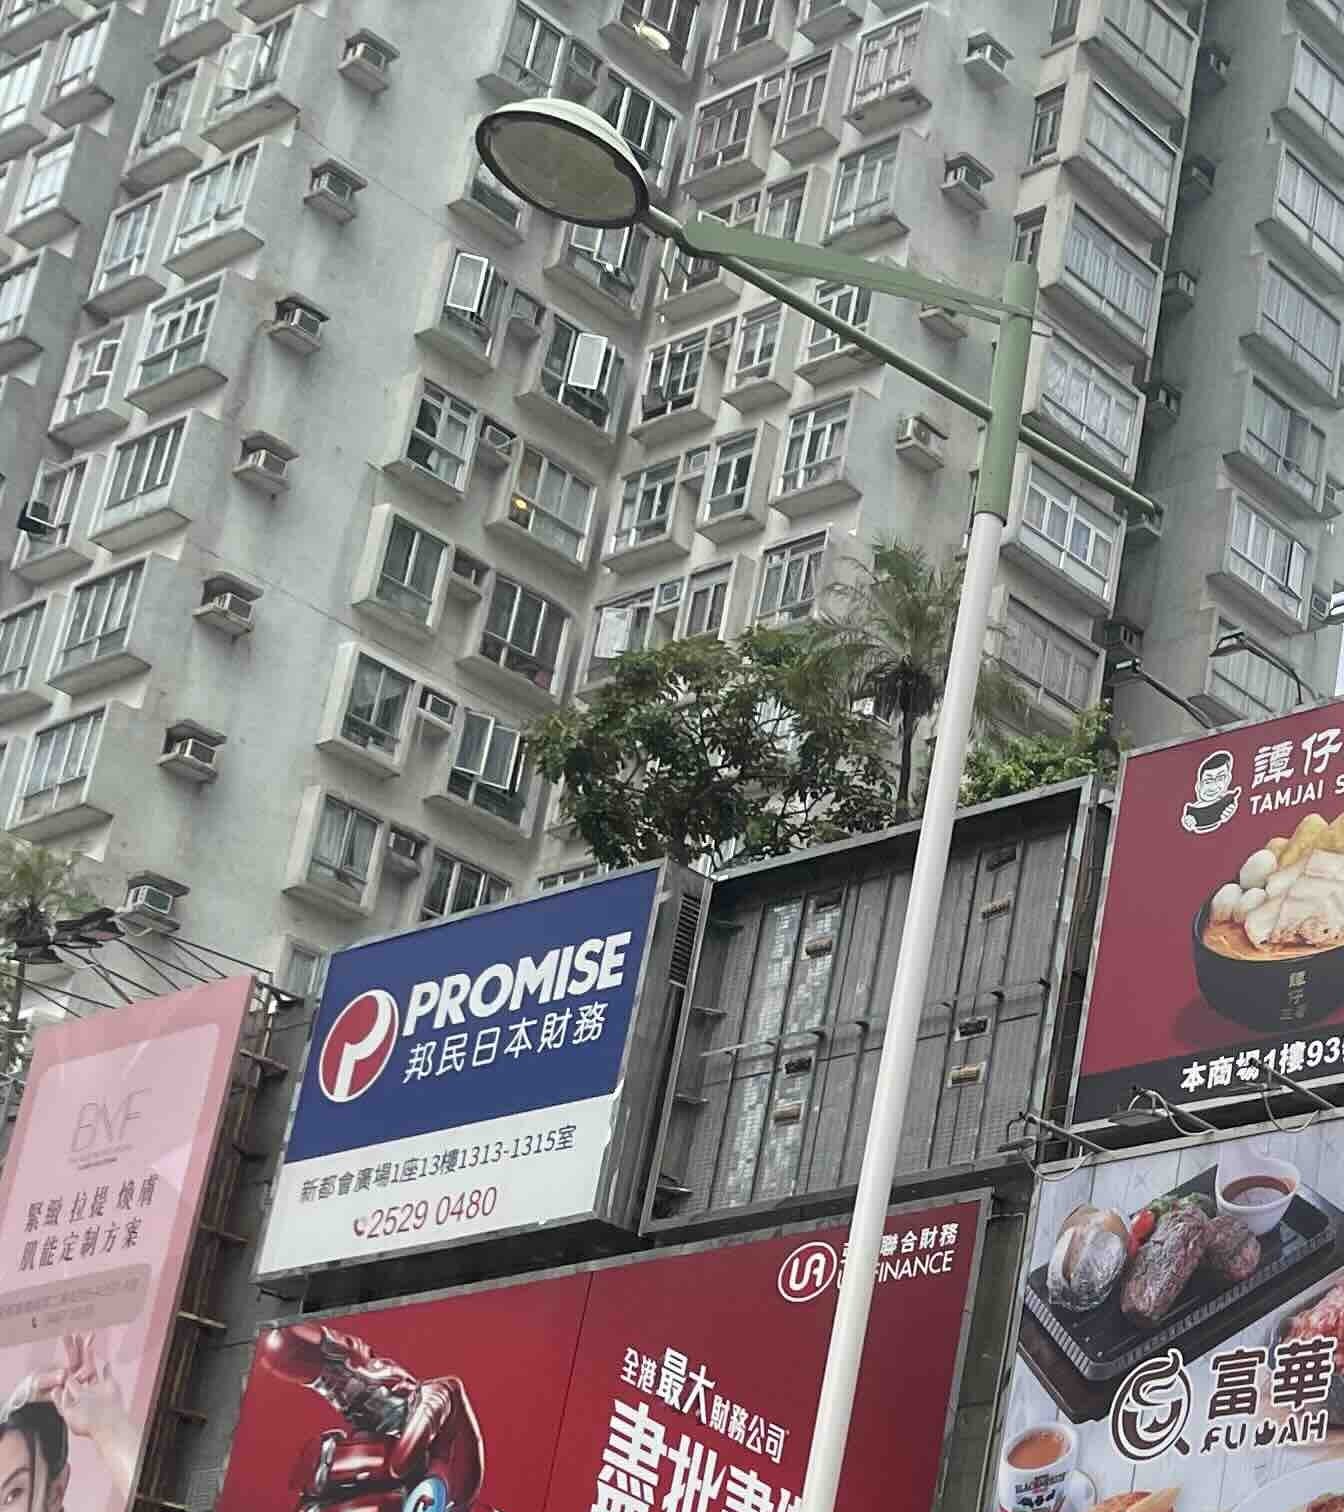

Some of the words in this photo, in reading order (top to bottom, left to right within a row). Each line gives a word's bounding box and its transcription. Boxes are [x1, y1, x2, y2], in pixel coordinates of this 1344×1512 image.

[1250, 778, 1325, 817] TAMJAI
[403, 931, 633, 1038] PROMISE
[403, 1001, 609, 1085] 邦民日本財務
[300, 1123, 578, 1205] 新都會廣場1座13樓1313-1315室
[366, 1199, 429, 1240] 2529
[434, 1186, 498, 1228] 0480
[841, 1222, 960, 1258] 聯合財務
[620, 1347, 790, 1465] 全港最大財務公司
[1206, 1337, 1338, 1421] 富華
